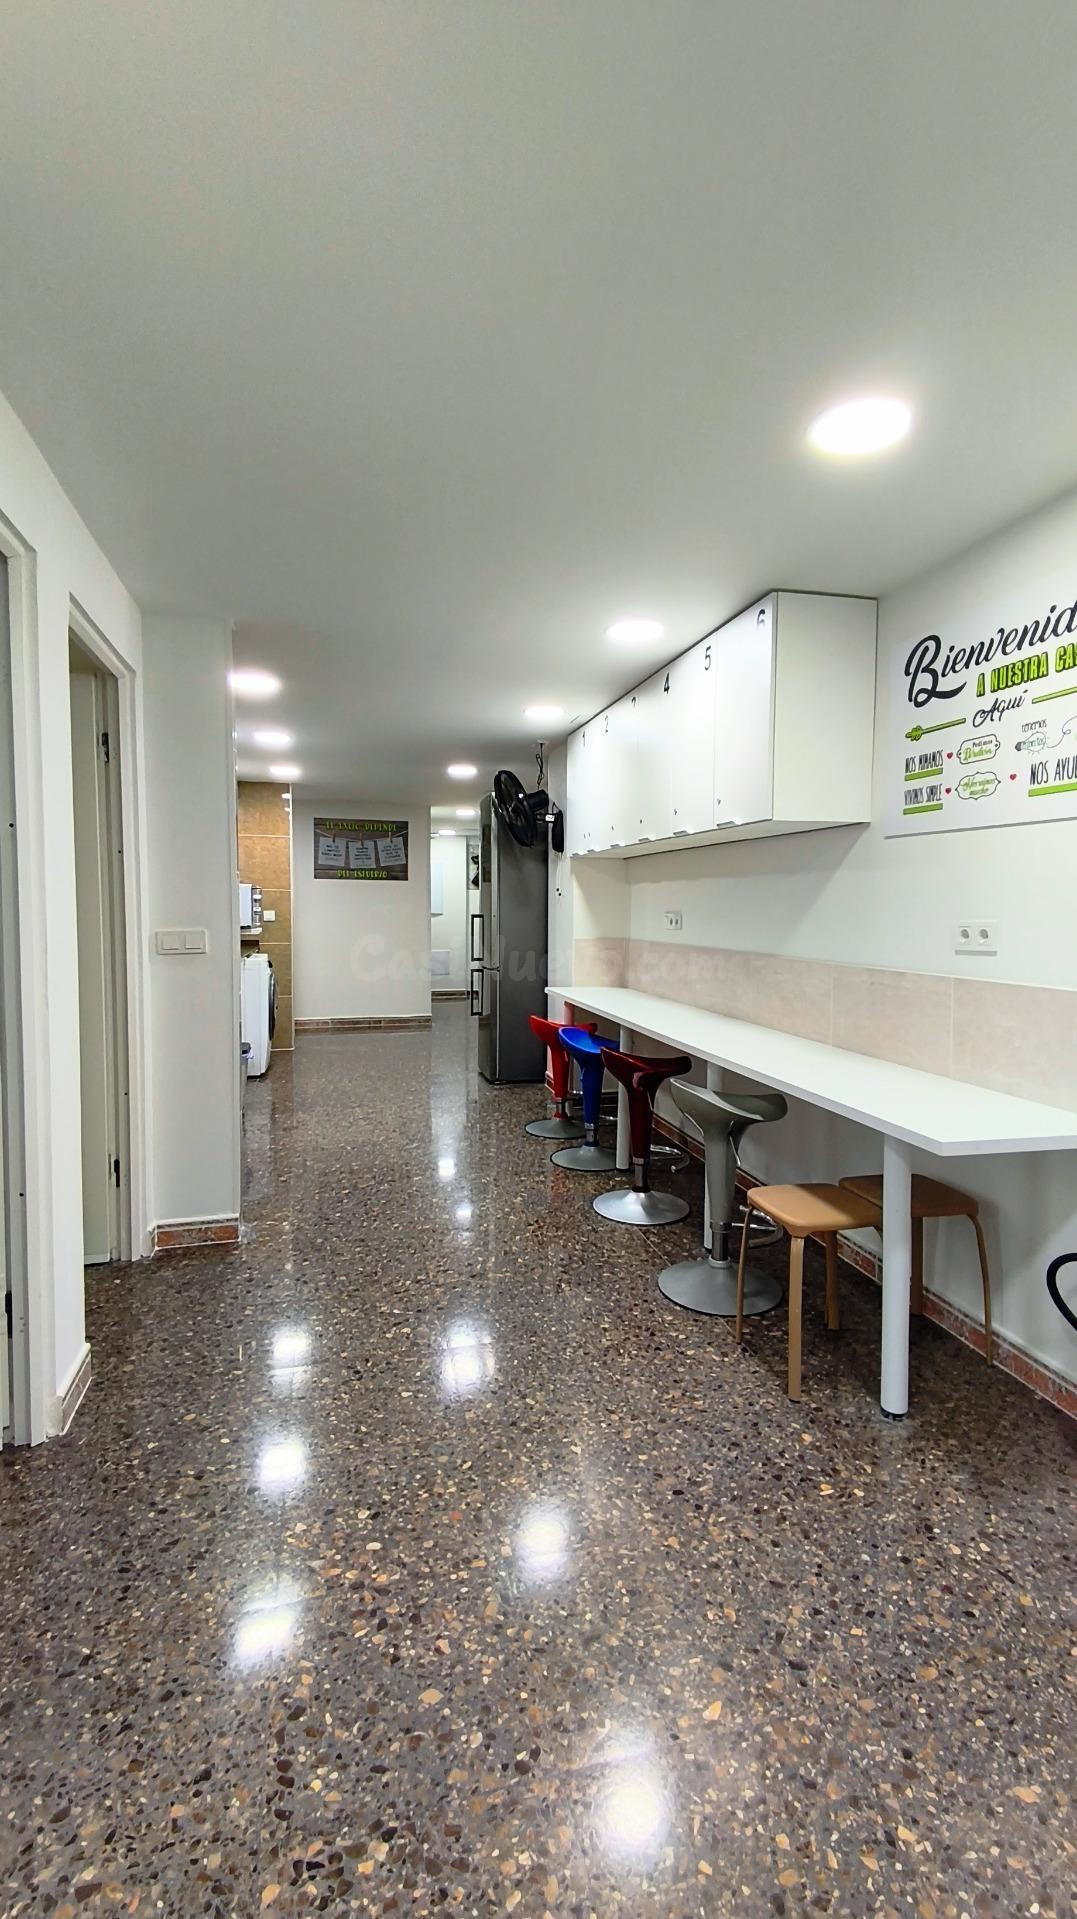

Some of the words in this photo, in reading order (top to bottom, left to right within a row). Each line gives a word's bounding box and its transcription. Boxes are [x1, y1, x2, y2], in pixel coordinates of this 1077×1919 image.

[704, 645, 712, 671] 5
[976, 673, 985, 697] A
[990, 651, 1049, 693] NUESTRA
[1055, 642, 1077, 673] CA
[663, 672, 670, 695] 4
[905, 756, 916, 774] NOS
[1030, 760, 1048, 785] NOS
